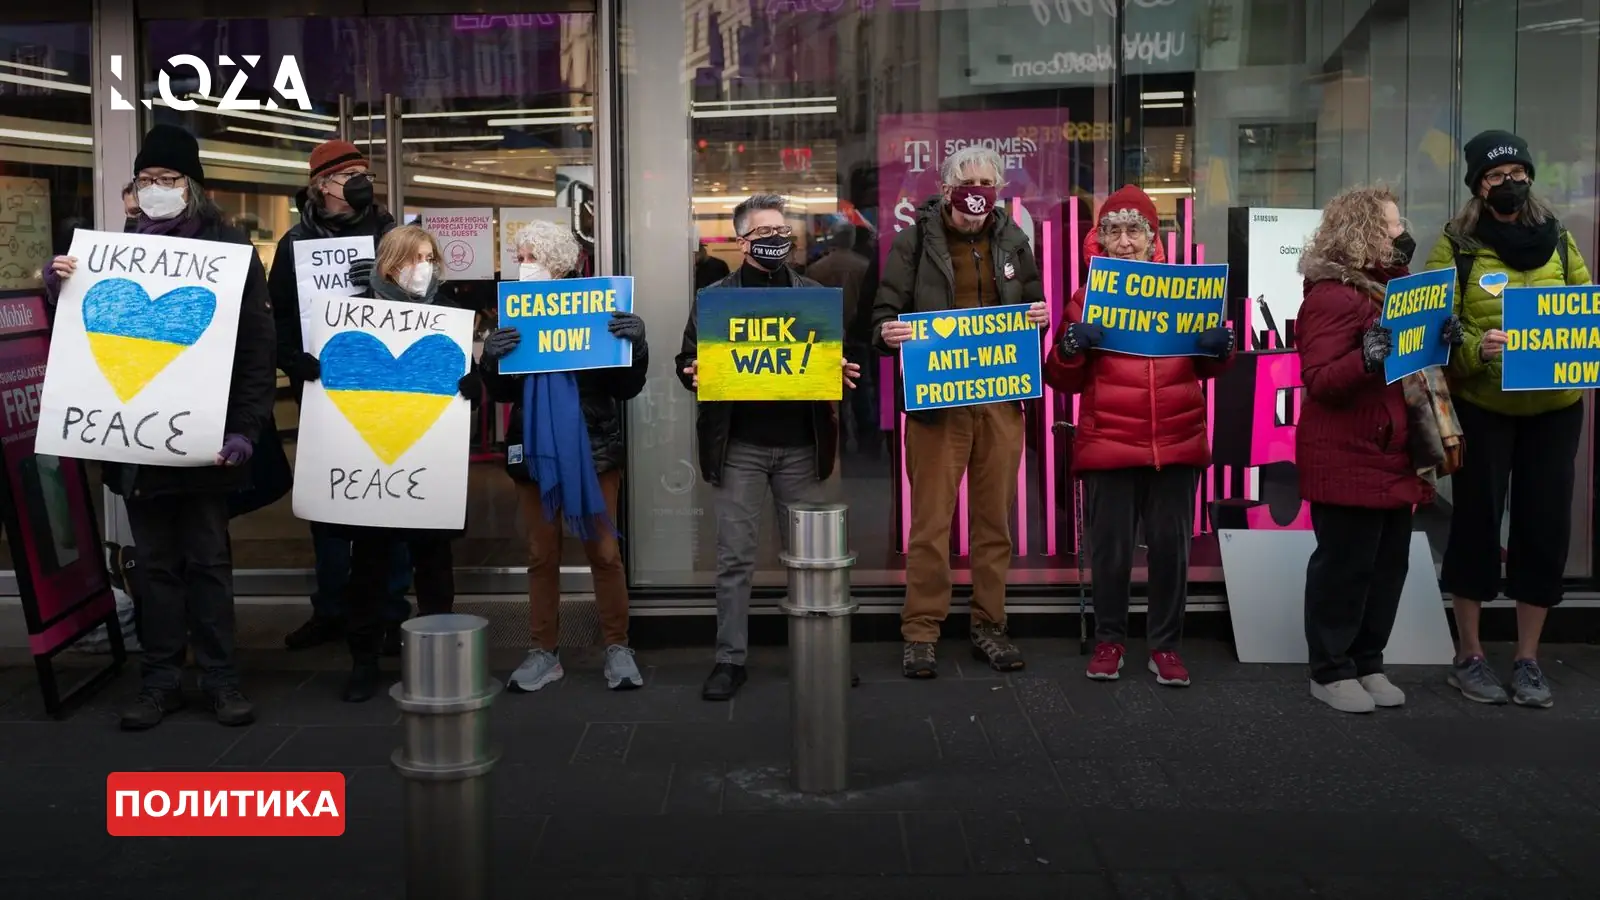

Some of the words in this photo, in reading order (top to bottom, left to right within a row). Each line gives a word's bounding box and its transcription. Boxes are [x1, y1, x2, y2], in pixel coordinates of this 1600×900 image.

[945, 138, 967, 155] 5G
[970, 137, 1021, 153] HOME
[1486, 146, 1518, 160] RESIST
[1253, 214, 1279, 222] SAMSUNG
[88, 244, 227, 283] UKRAINE
[312, 248, 358, 267] STOP
[1279, 245, 1302, 255] Galaxy
[1090, 269, 1120, 294] WE
[1125, 273, 1226, 299] CONDEMN
[506, 289, 617, 318] CEASEFIRE
[1386, 283, 1448, 320] CEASEFIRE
[1537, 292, 1600, 316] NUCLE
[325, 300, 447, 332] UKRAINE
[729, 317, 797, 342] FUCK
[958, 311, 1037, 337] RUSSIAN
[1087, 304, 1169, 334] PUTIN'S
[1176, 312, 1219, 334] WAR
[538, 327, 591, 353] NOW!
[1398, 325, 1426, 357] NOW!
[1506, 327, 1600, 351] DISARMA
[928, 344, 1017, 372] ANTI-WAR
[1553, 361, 1600, 384] NOW
[915, 374, 1032, 404] PROTESTORS
[63, 406, 191, 456] PEACE
[330, 467, 427, 500] PEACE
